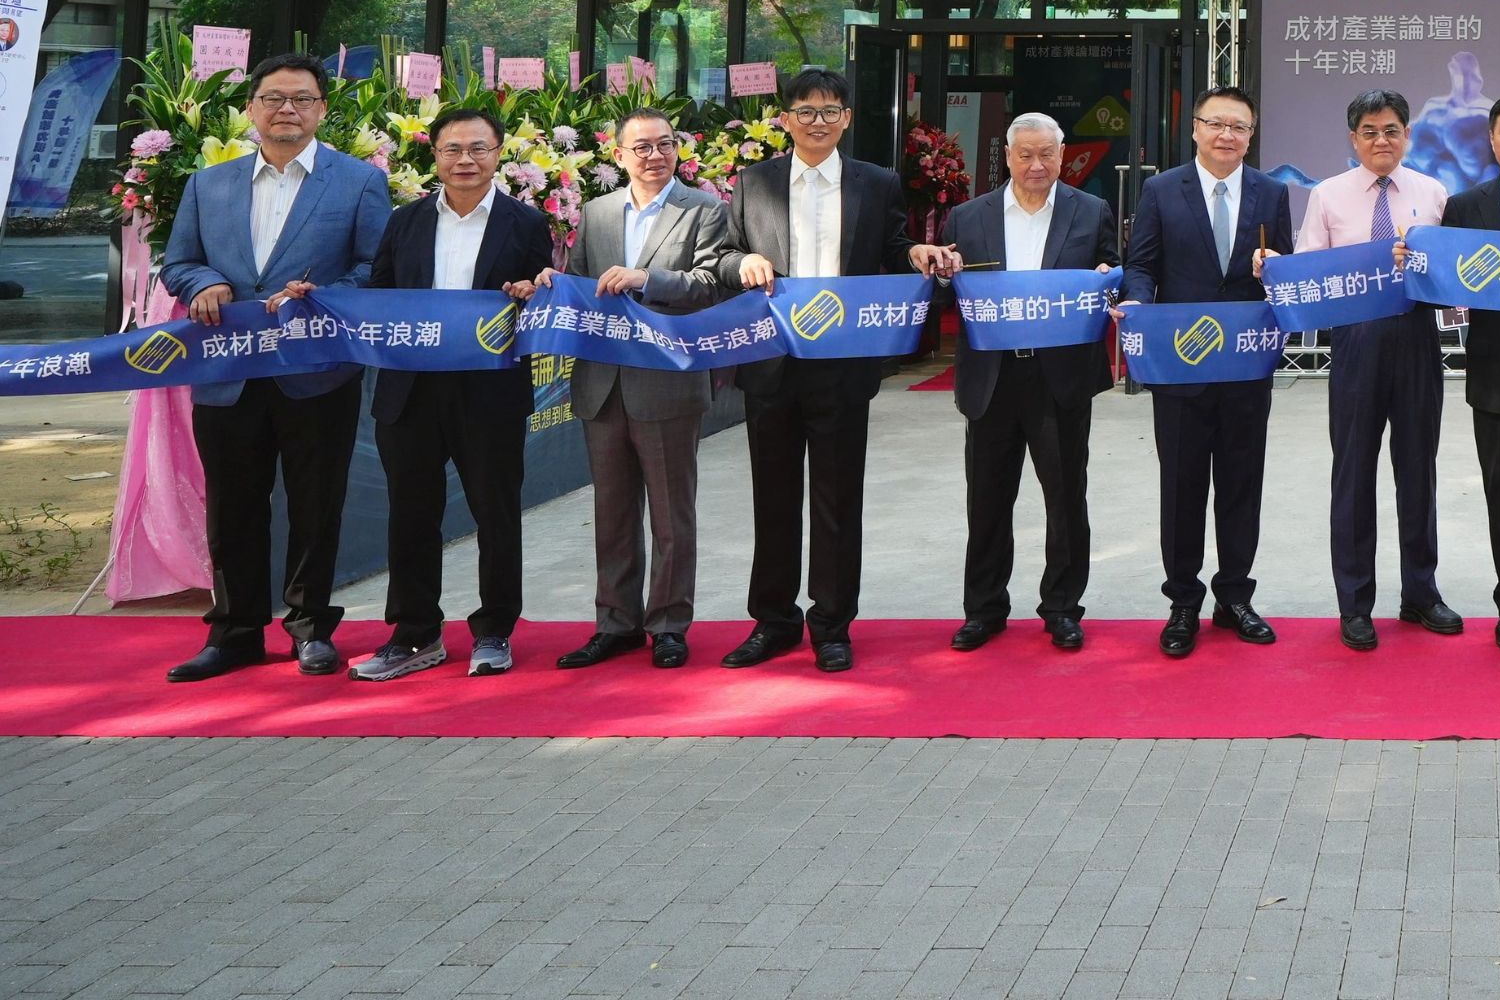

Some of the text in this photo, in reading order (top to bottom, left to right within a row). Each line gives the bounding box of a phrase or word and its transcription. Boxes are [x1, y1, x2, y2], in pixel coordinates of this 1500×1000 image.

[1284, 14, 1483, 41] 成材產業論壇的
[1284, 49, 1397, 75] 十年浪潮
[946, 95, 969, 105] EAA
[1405, 250, 1429, 275] 潮
[856, 299, 931, 329] 成材產
[279, 314, 442, 348] 壇的十年浪潮
[514, 303, 778, 355] 成材產業論壇的十年浪潮
[202, 328, 284, 360] 成材產
[1121, 330, 1144, 358] 潮
[529, 402, 577, 433] 思想到產
